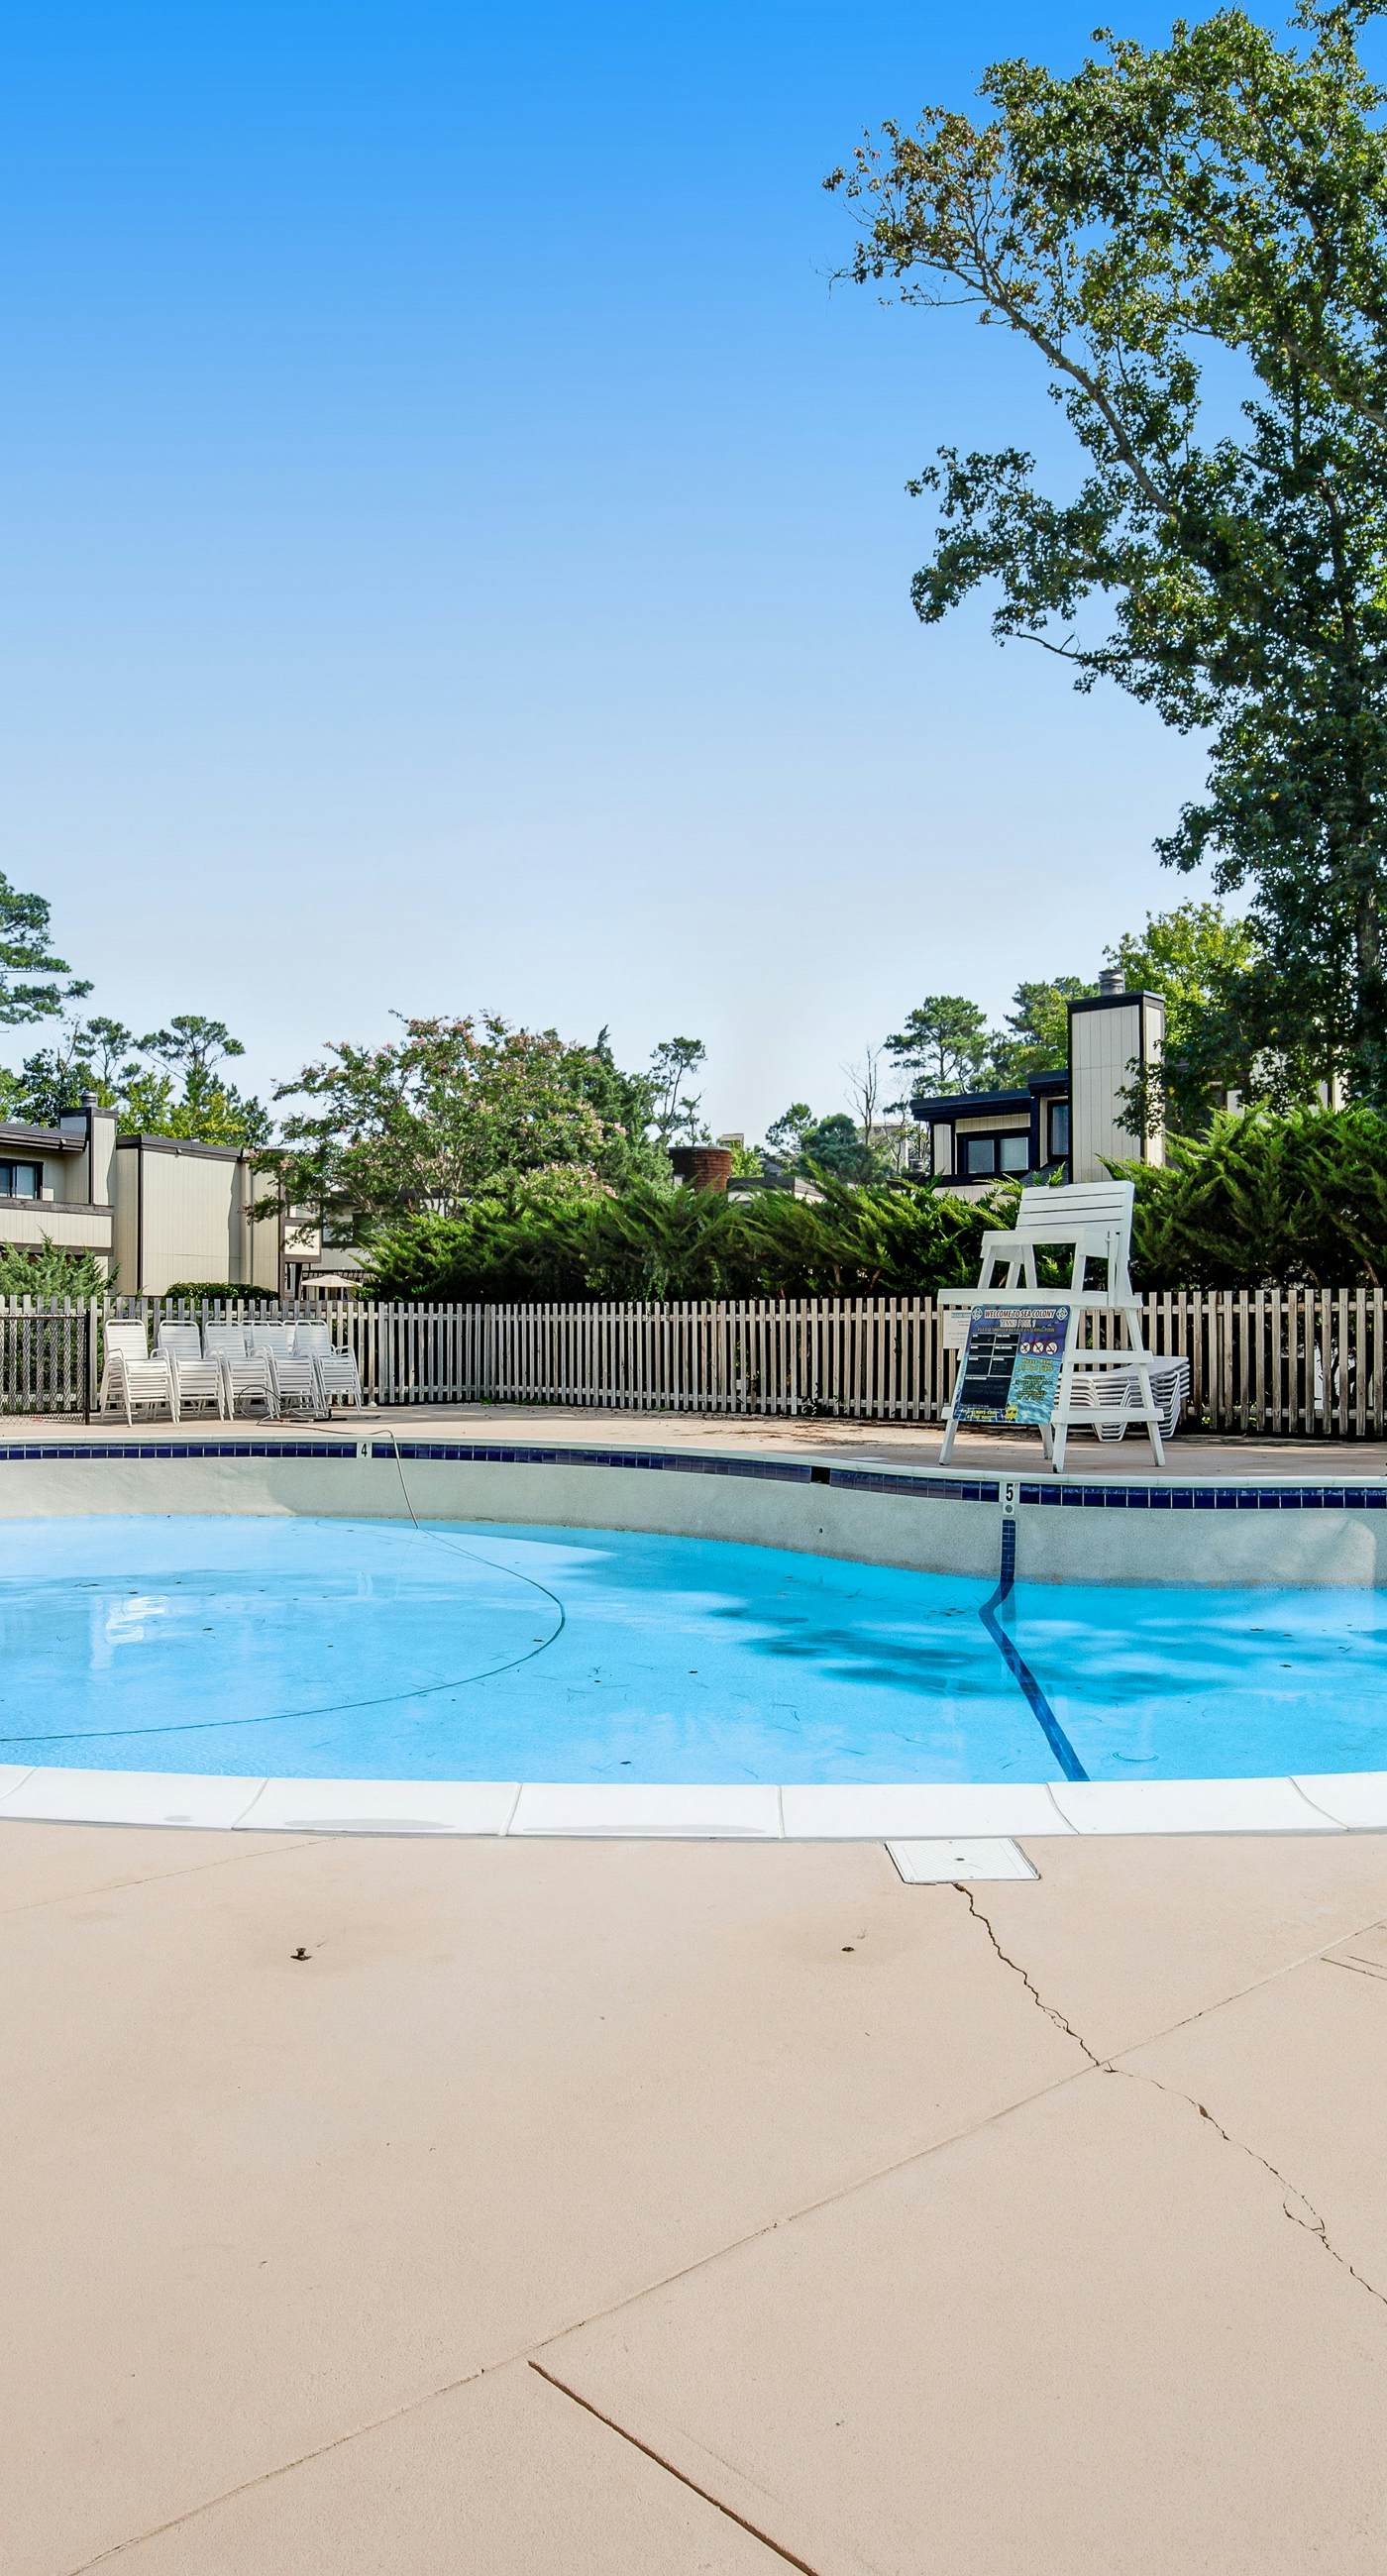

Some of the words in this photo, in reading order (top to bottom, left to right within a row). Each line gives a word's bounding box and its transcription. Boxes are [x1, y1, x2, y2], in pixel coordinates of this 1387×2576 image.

[1031, 1310, 1056, 1319] COLONY
[362, 1444, 368, 1457] 4
[1006, 1483, 1014, 1501] 5
